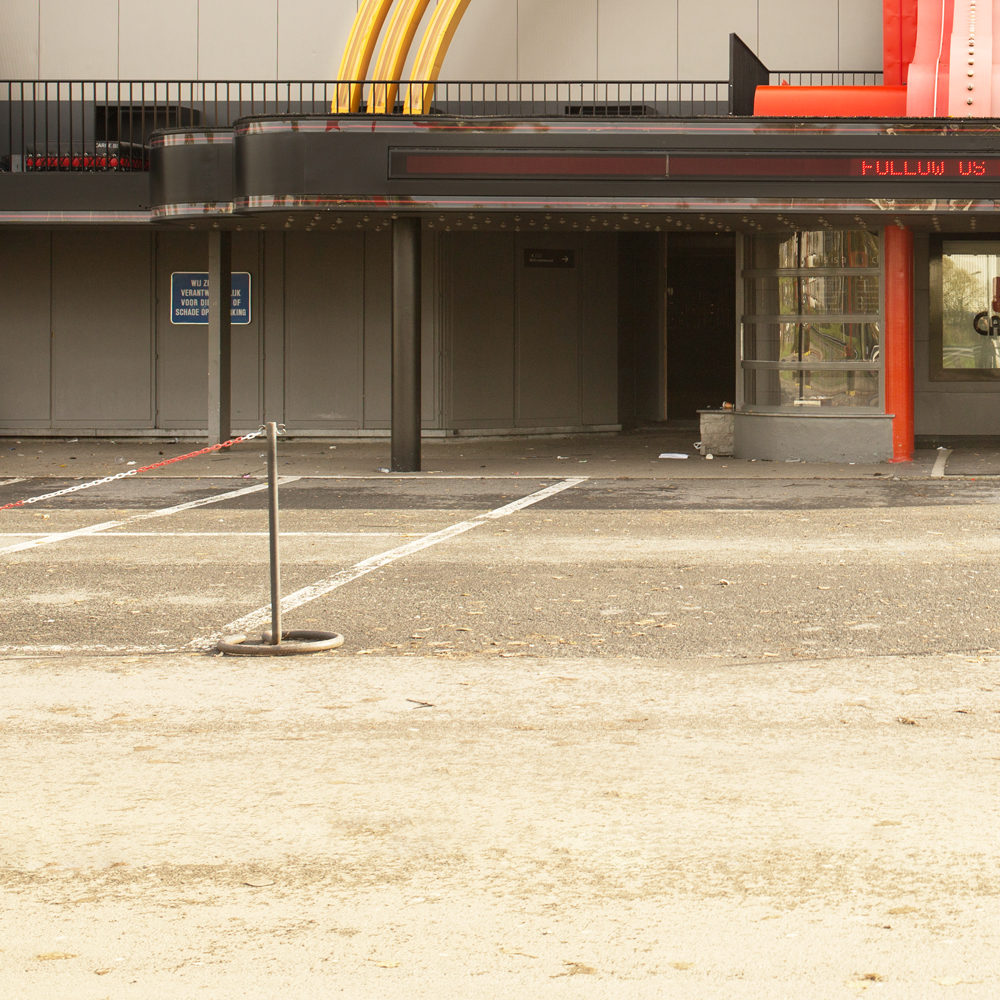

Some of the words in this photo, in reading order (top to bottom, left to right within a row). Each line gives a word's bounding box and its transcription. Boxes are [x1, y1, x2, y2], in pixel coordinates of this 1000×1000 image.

[959, 160, 986, 176] US
[190, 279, 202, 287] WIJ
[175, 308, 200, 316] SCHADE
